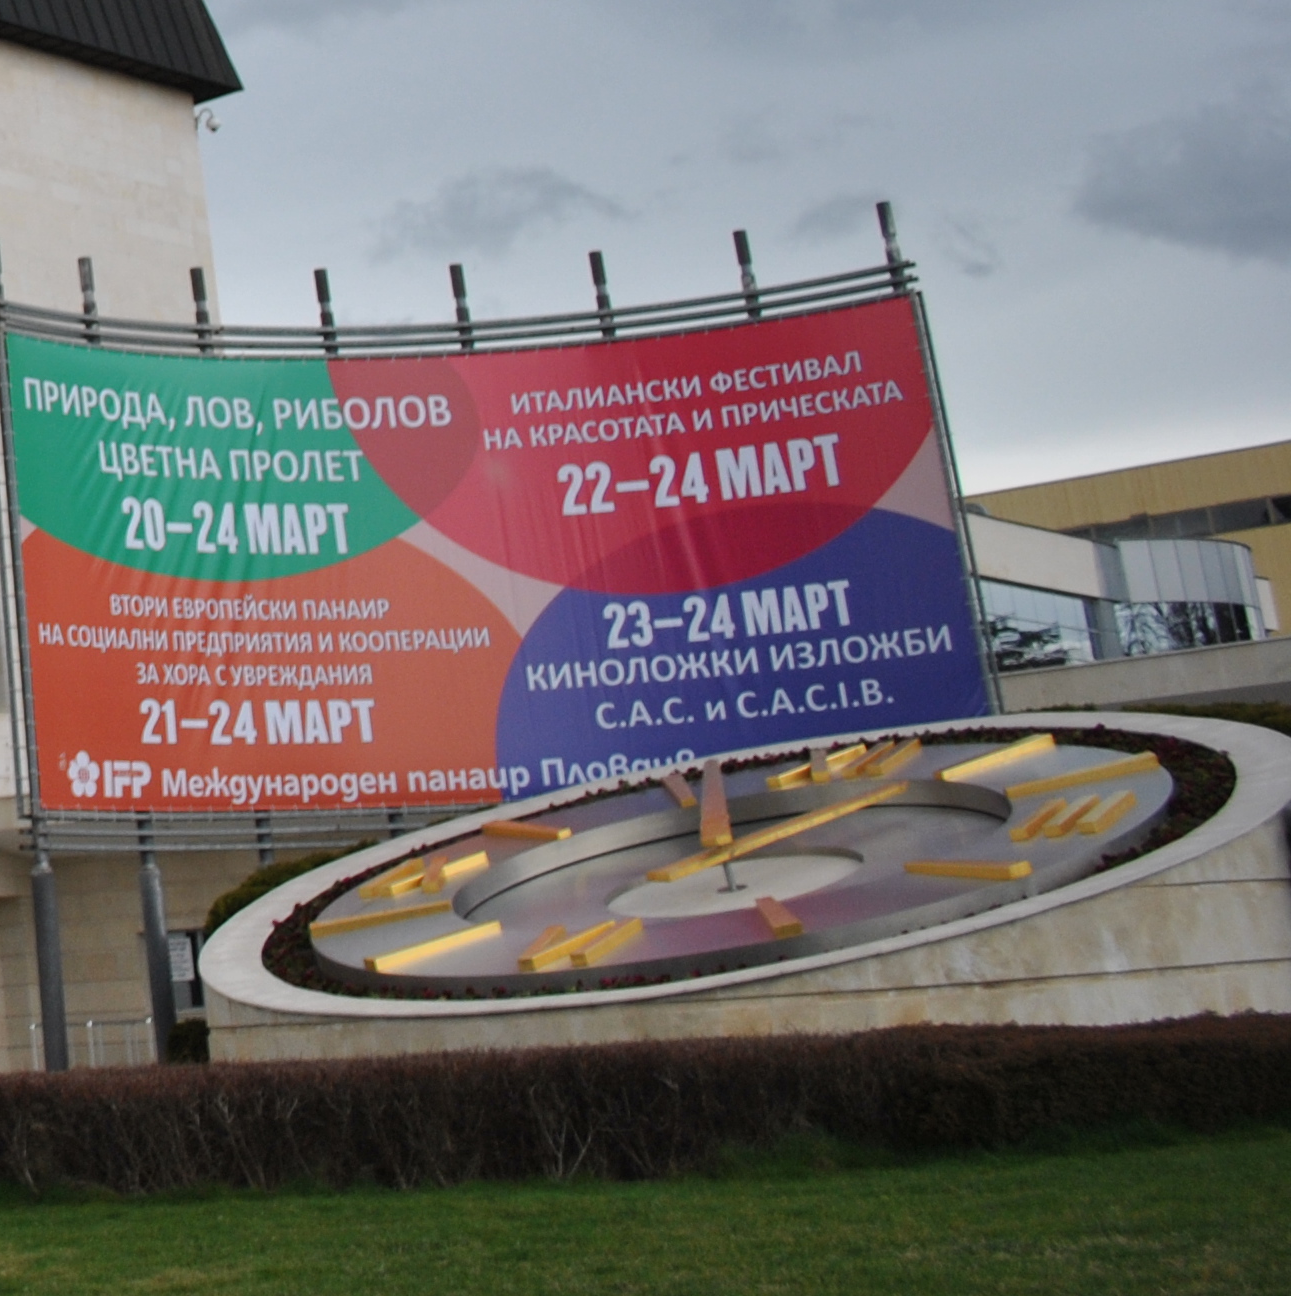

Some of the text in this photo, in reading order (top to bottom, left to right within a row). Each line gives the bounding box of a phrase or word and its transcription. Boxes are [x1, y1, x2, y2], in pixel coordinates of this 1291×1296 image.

[23, 377, 452, 435] ПРИРОДА, ЛОВ, РИБОЛОВ
[510, 350, 862, 415] ИТАЛИАНСКИ ФЕСТИВАЛ
[483, 380, 903, 451] НА КРАСОТАТА И ПРИЧЕСКАТА
[99, 440, 363, 482] ЦВЕТНА ПРОЛЕТ
[715, 433, 840, 501] МАРТ
[243, 502, 349, 555] МАРТ
[109, 594, 389, 621] ВТОРИ ЕВРОПЕЙСКИ ПАНАИР
[741, 579, 850, 637] МАРТ
[38, 623, 490, 657] НА СОЦИАЛНИ ПРЕДПРИЯТИЯ И КООПЕРАЦИИ
[526, 624, 953, 691] КИНОЛОЖКИ ИЗЛОЖБИ
[136, 662, 373, 690] ЗА ХОРА С УВРЕЖДАНИЯ
[265, 698, 374, 744] МАРТ
[103, 760, 152, 798] IFP
[162, 767, 397, 804] Международен
[408, 764, 530, 795] панаир
